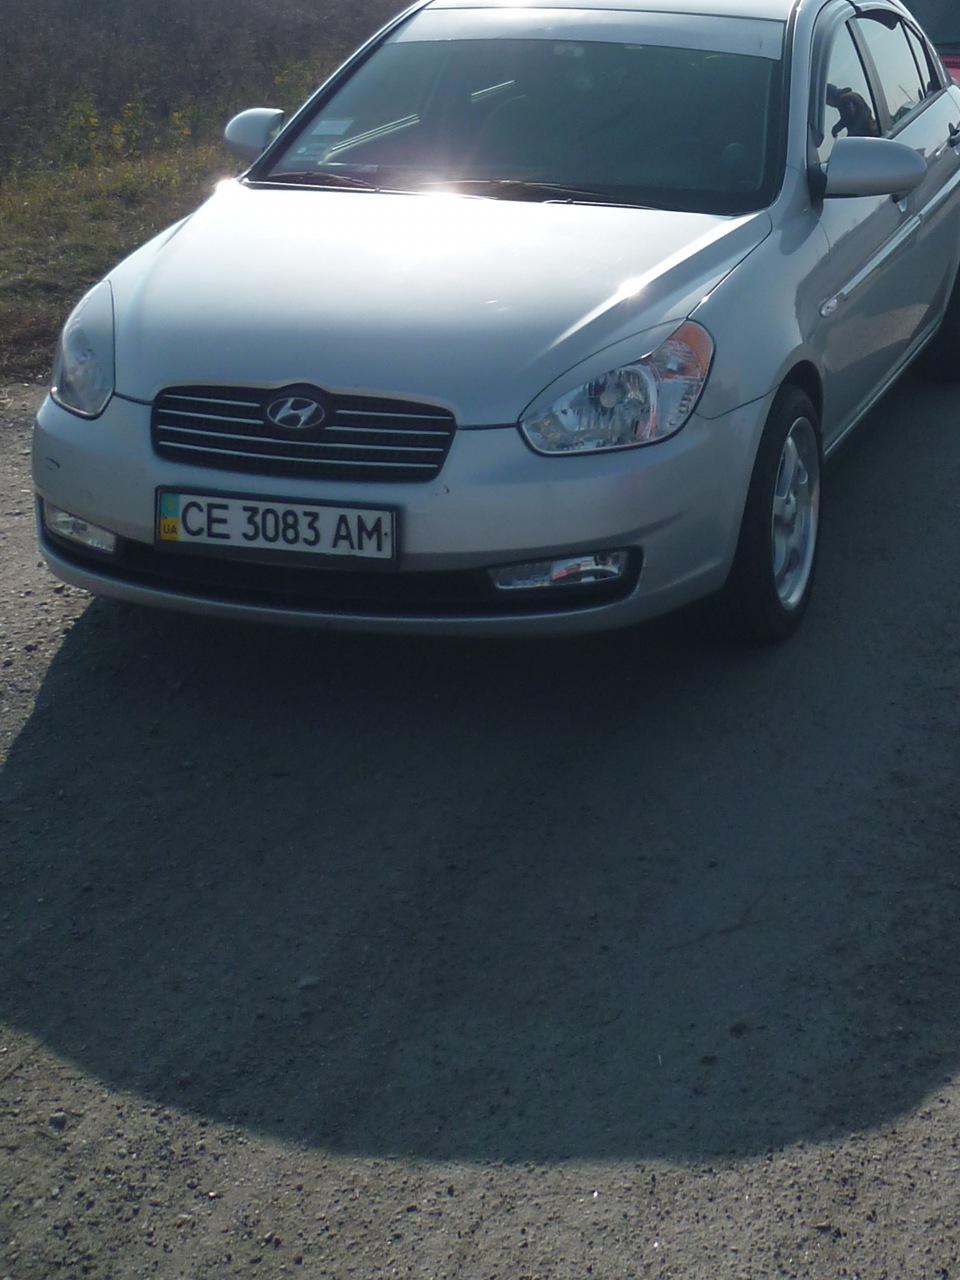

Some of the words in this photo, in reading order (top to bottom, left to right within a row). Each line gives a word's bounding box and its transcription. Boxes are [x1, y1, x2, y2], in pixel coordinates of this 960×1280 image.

[162, 525, 178, 536] UA
[181, 501, 230, 540] CE
[242, 506, 321, 547] 3083
[332, 513, 383, 552] AM
